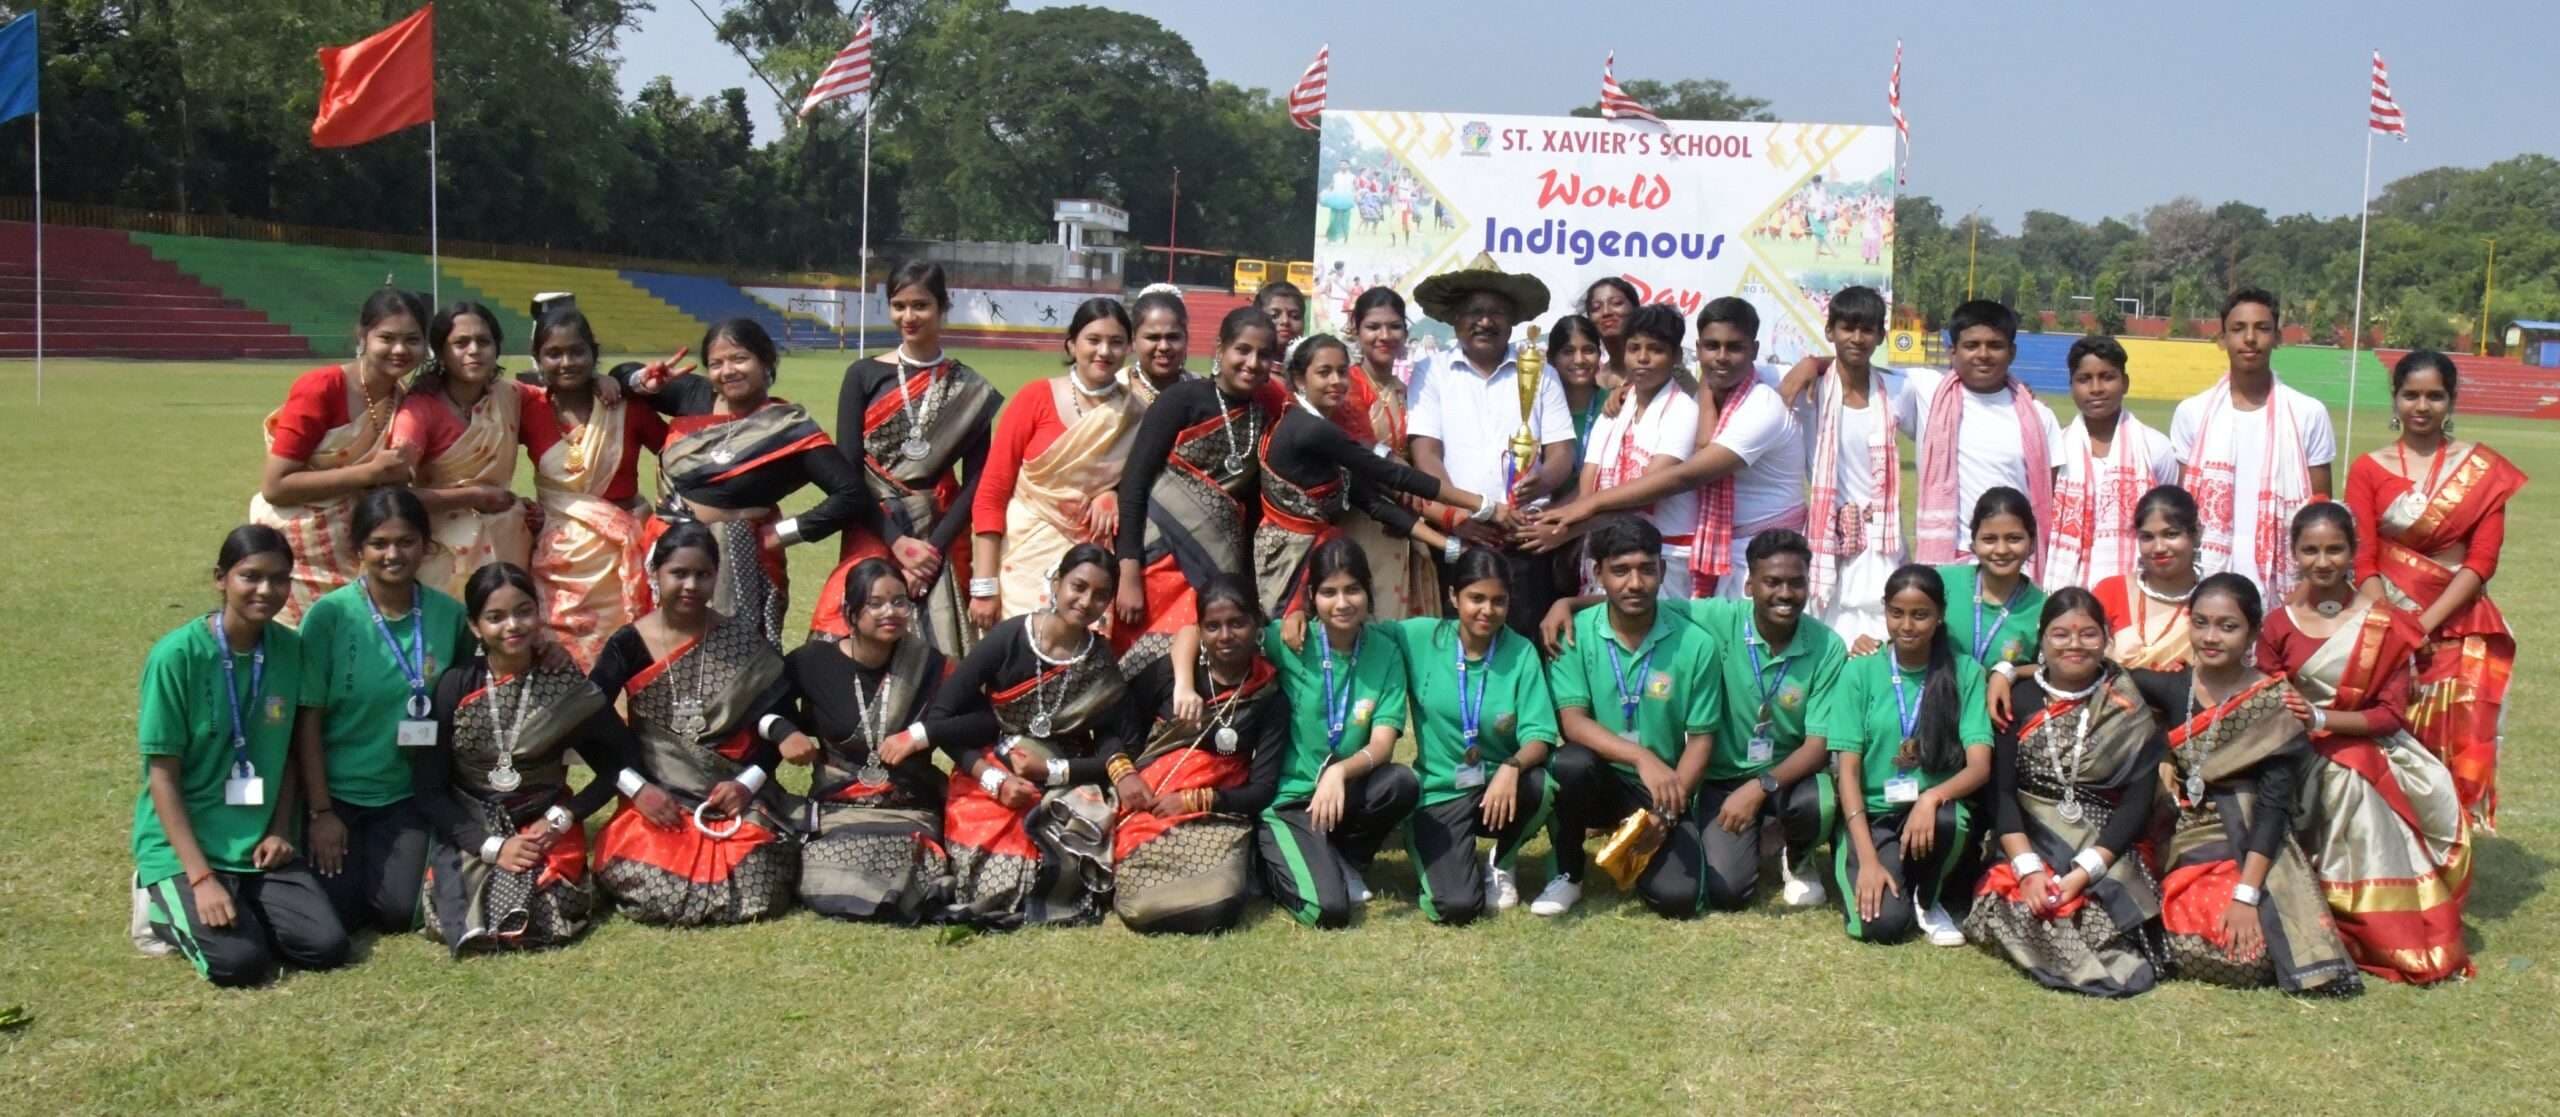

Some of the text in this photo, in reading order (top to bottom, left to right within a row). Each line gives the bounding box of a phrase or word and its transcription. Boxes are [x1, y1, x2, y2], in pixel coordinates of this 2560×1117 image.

[1502, 128, 1752, 158] ST. XAVIER'S SCHOOL
[1537, 169, 1672, 210] World
[1485, 217, 1725, 266] Indigenous
